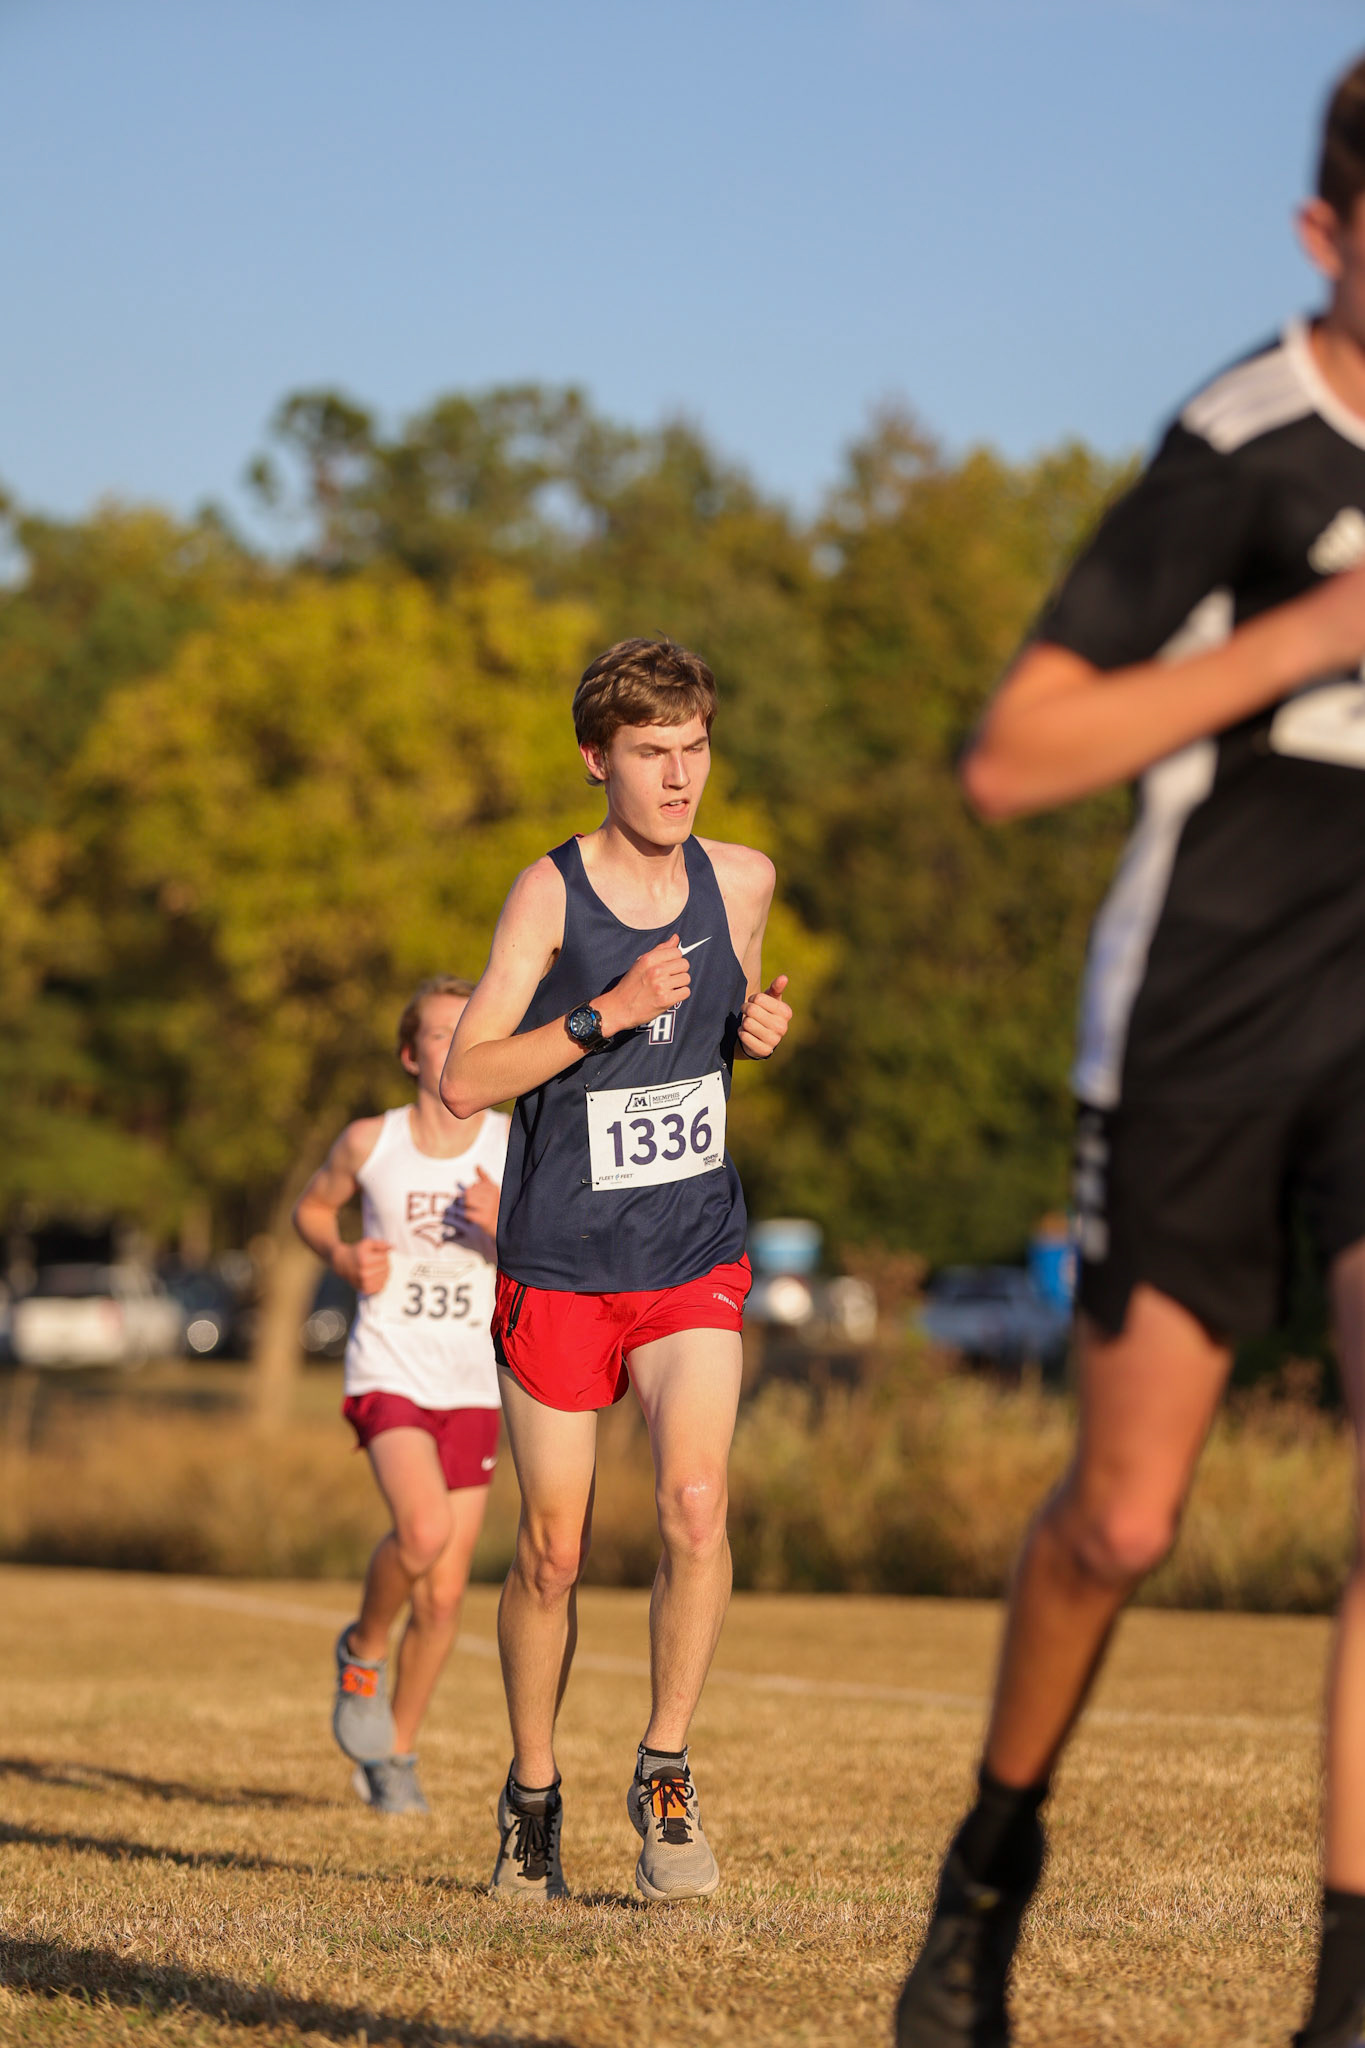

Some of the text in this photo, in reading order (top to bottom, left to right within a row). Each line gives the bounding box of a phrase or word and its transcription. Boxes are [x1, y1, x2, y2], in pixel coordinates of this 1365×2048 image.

[652, 1092, 680, 1102] MEMPHIS
[606, 1106, 711, 1167] 1336
[403, 1282, 471, 1319] 335
